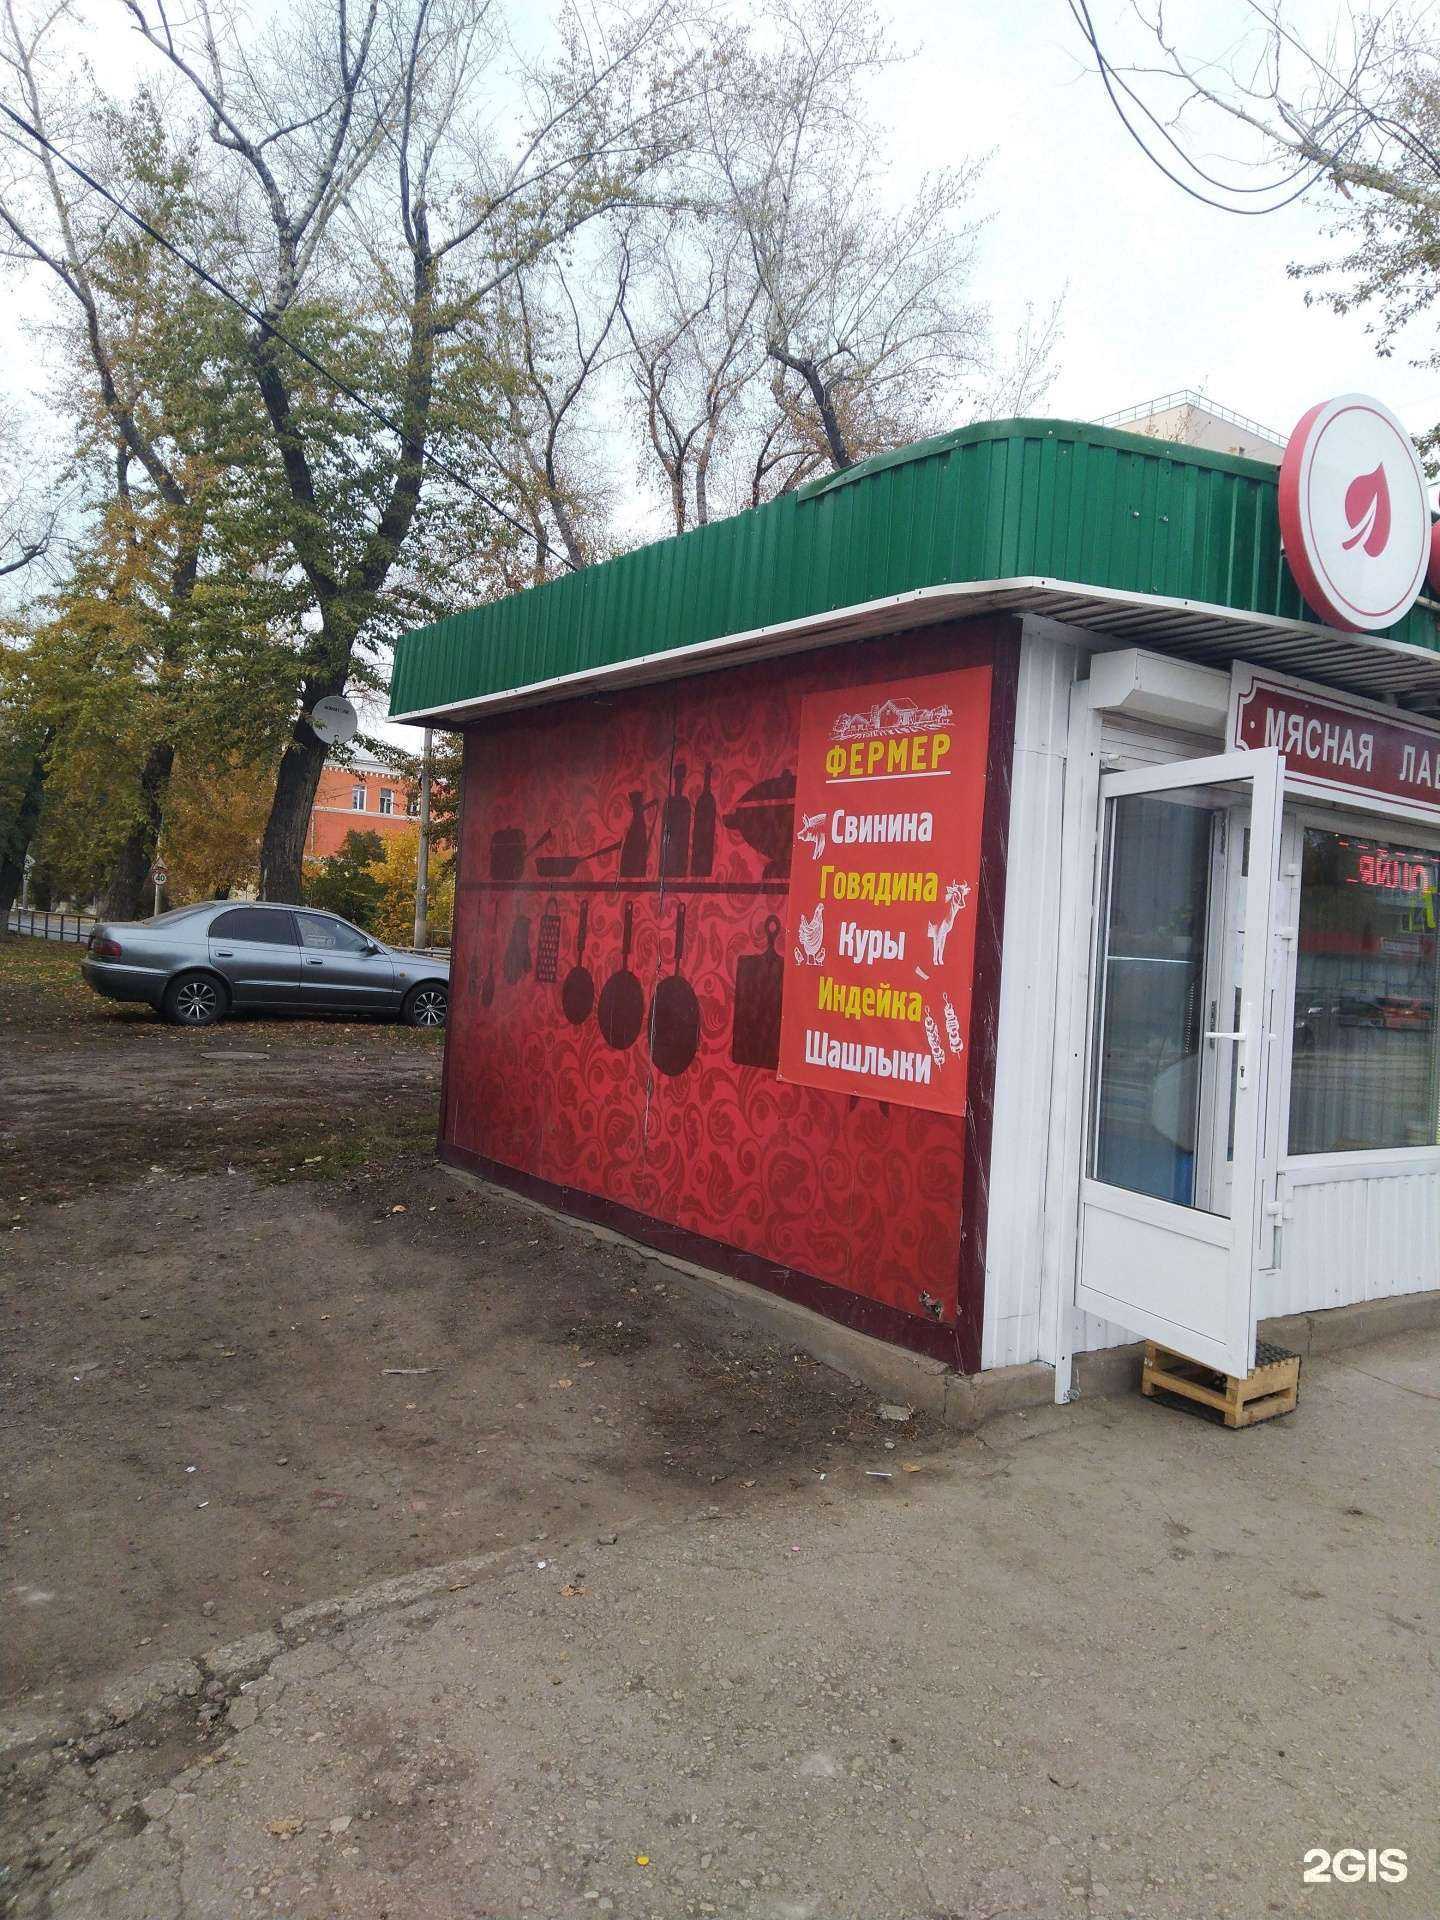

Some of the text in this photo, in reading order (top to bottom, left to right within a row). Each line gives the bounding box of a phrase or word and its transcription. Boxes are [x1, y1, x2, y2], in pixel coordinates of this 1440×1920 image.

[825, 733, 951, 777] ФЕРМЕР
[1264, 708, 1374, 772] МЯСНАЯ
[831, 809, 933, 845] Свинина
[820, 866, 937, 905] Говядина
[839, 922, 905, 964] Куры
[818, 976, 922, 1023] Индейка
[805, 1030, 932, 1084] Шашлыки
